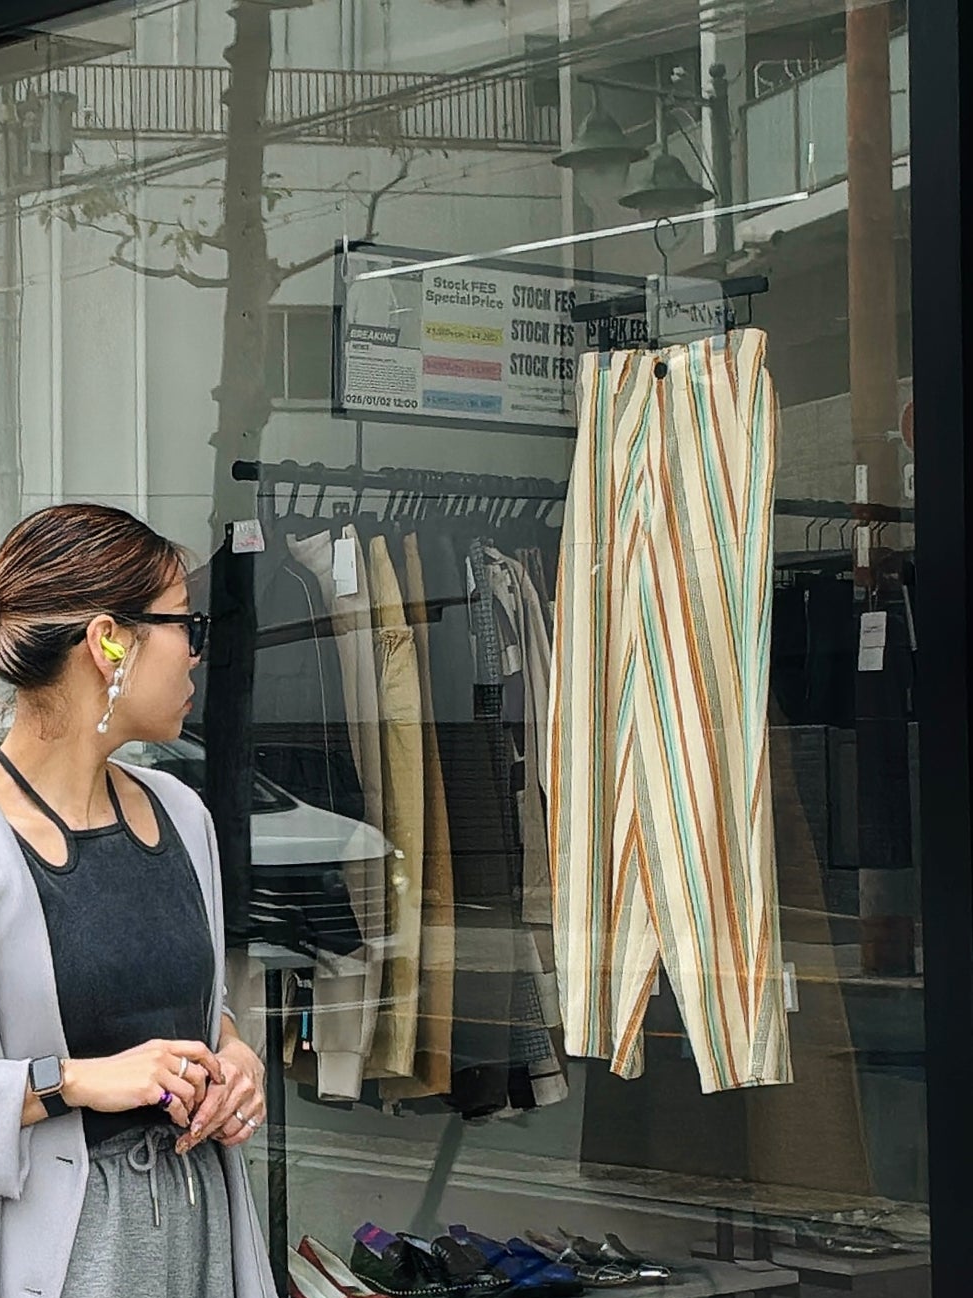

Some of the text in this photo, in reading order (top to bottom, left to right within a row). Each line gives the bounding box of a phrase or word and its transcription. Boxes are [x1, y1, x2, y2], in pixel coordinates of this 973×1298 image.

[425, 289, 504, 309] Special Price
[433, 276, 497, 294] Stock FES
[512, 284, 551, 311] STOCK
[554, 288, 577, 315] FES
[510, 319, 550, 345] STOCK
[553, 323, 575, 347] FES
[509, 352, 549, 379] STOCK
[552, 357, 574, 381] FES
